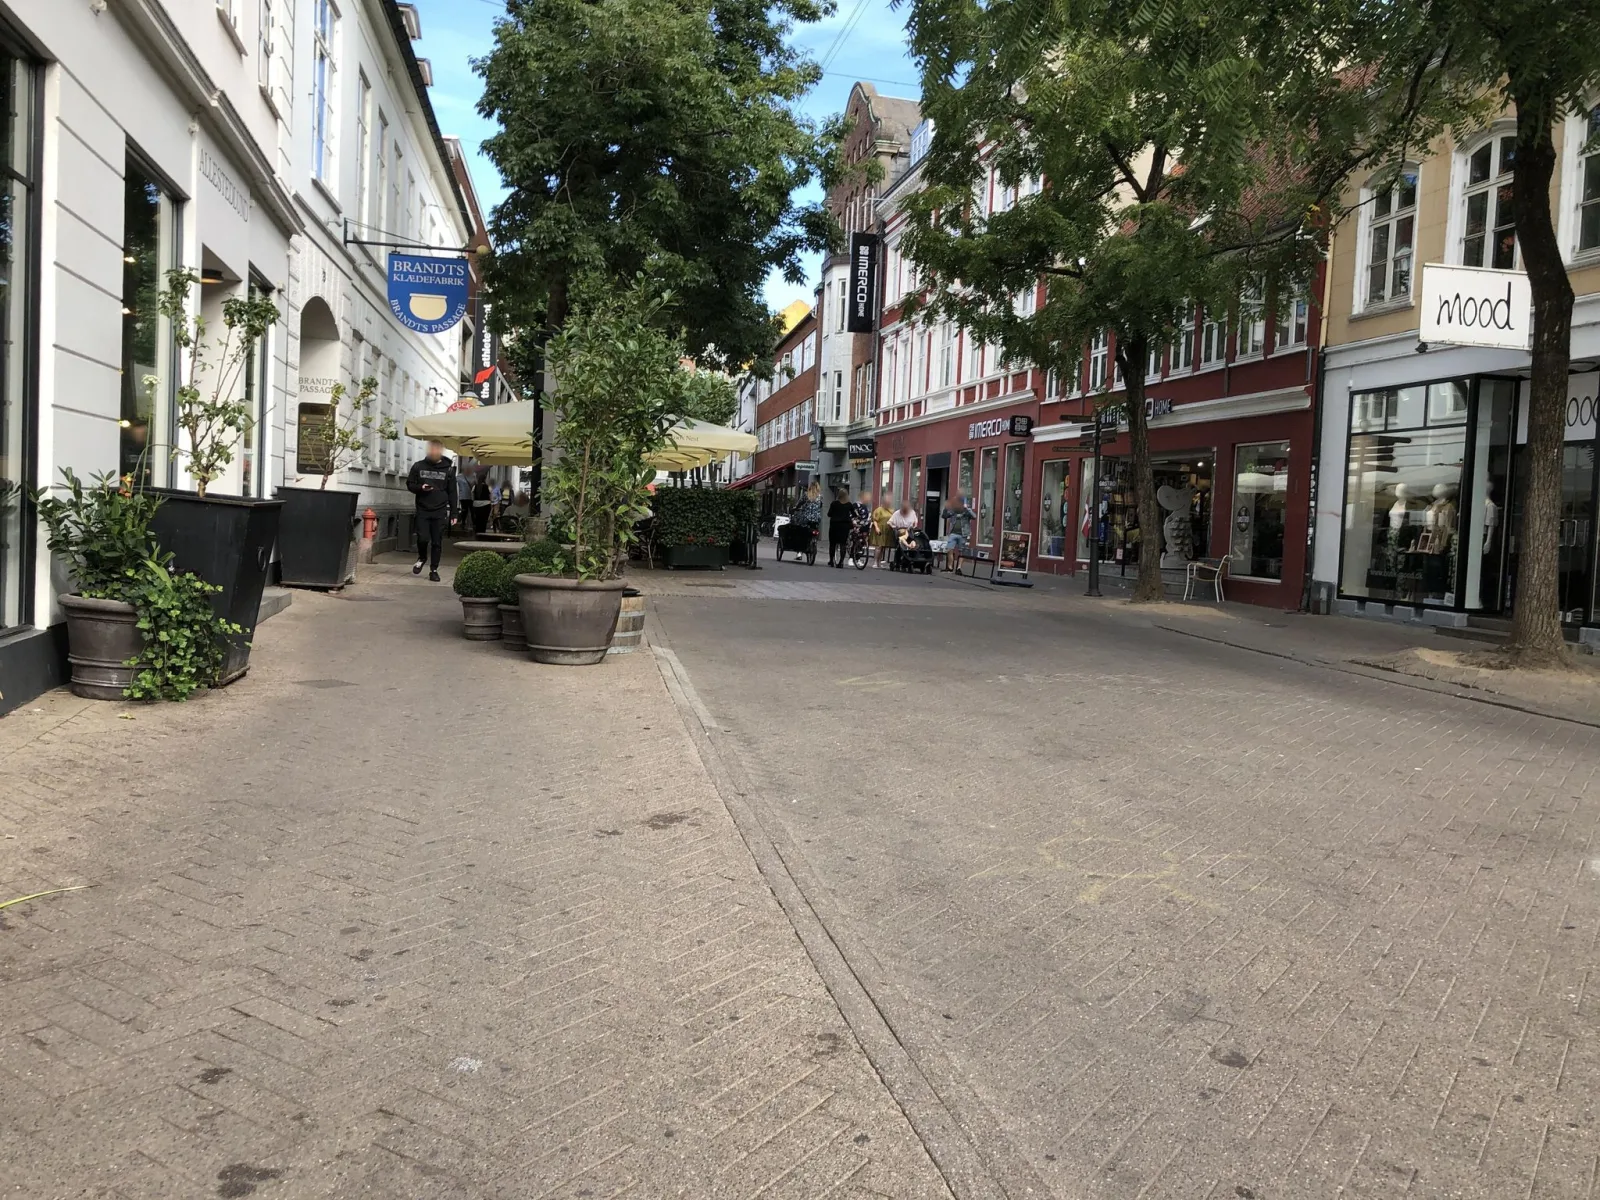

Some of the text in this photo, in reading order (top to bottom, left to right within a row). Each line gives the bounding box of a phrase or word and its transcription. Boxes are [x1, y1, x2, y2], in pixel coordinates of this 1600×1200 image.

[393, 260, 465, 276] BRANDTS
[393, 273, 465, 286] KLÆDEFABRIK
[856, 256, 869, 303] IMERCO
[1436, 281, 1515, 330] mood
[390, 299, 466, 332] BRANDTS PASSAGE
[299, 376, 338, 386] BRANDTS
[299, 385, 333, 394] PASSAG
[480, 381, 490, 399] the
[1154, 398, 1171, 415] HOME
[974, 418, 1002, 439] IMERCO
